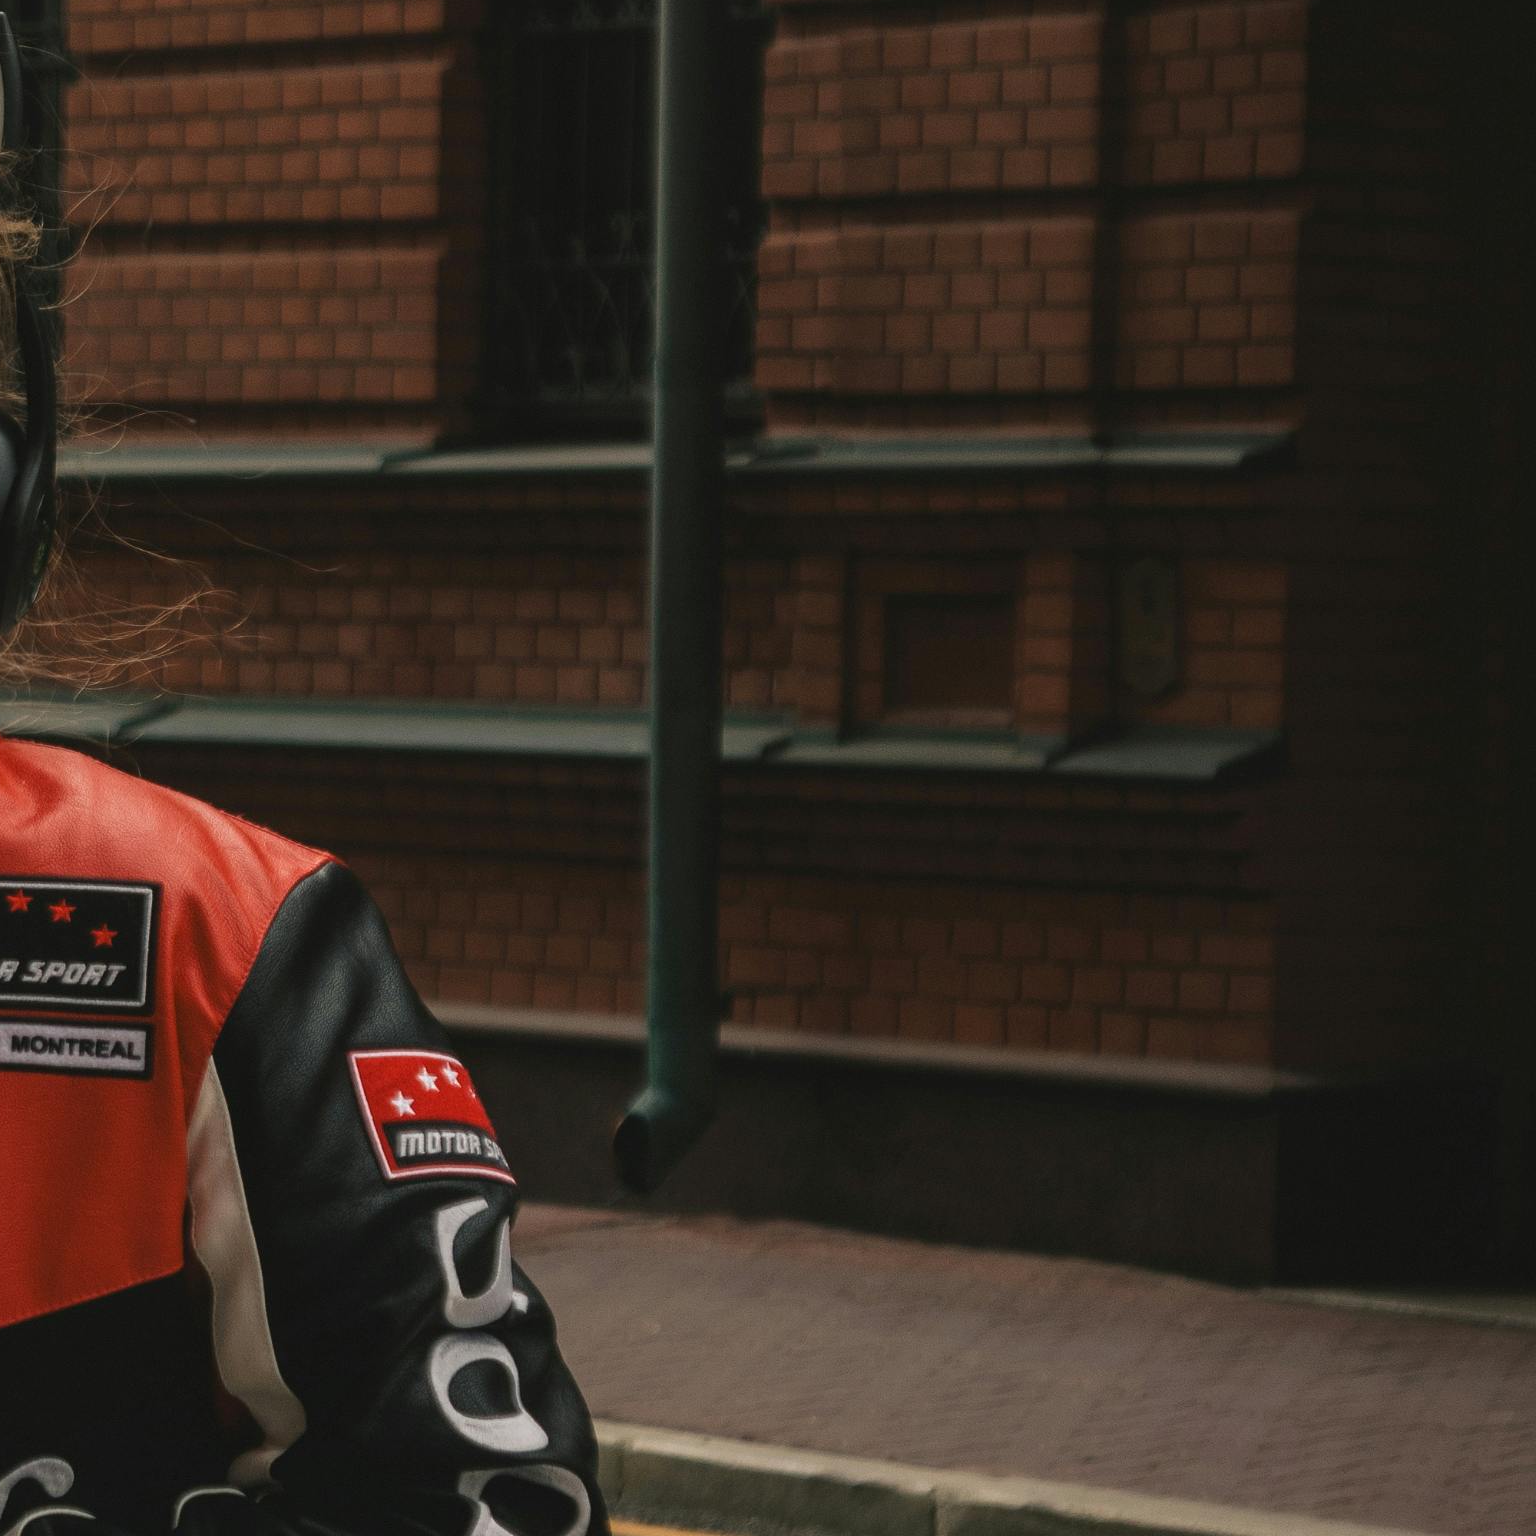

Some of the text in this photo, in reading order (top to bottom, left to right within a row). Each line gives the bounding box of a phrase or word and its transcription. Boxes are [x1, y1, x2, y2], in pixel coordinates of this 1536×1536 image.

[21, 961, 127, 987] SPORT
[10, 1034, 142, 1061] MONTREAL
[398, 1130, 482, 1158] MOTOR
